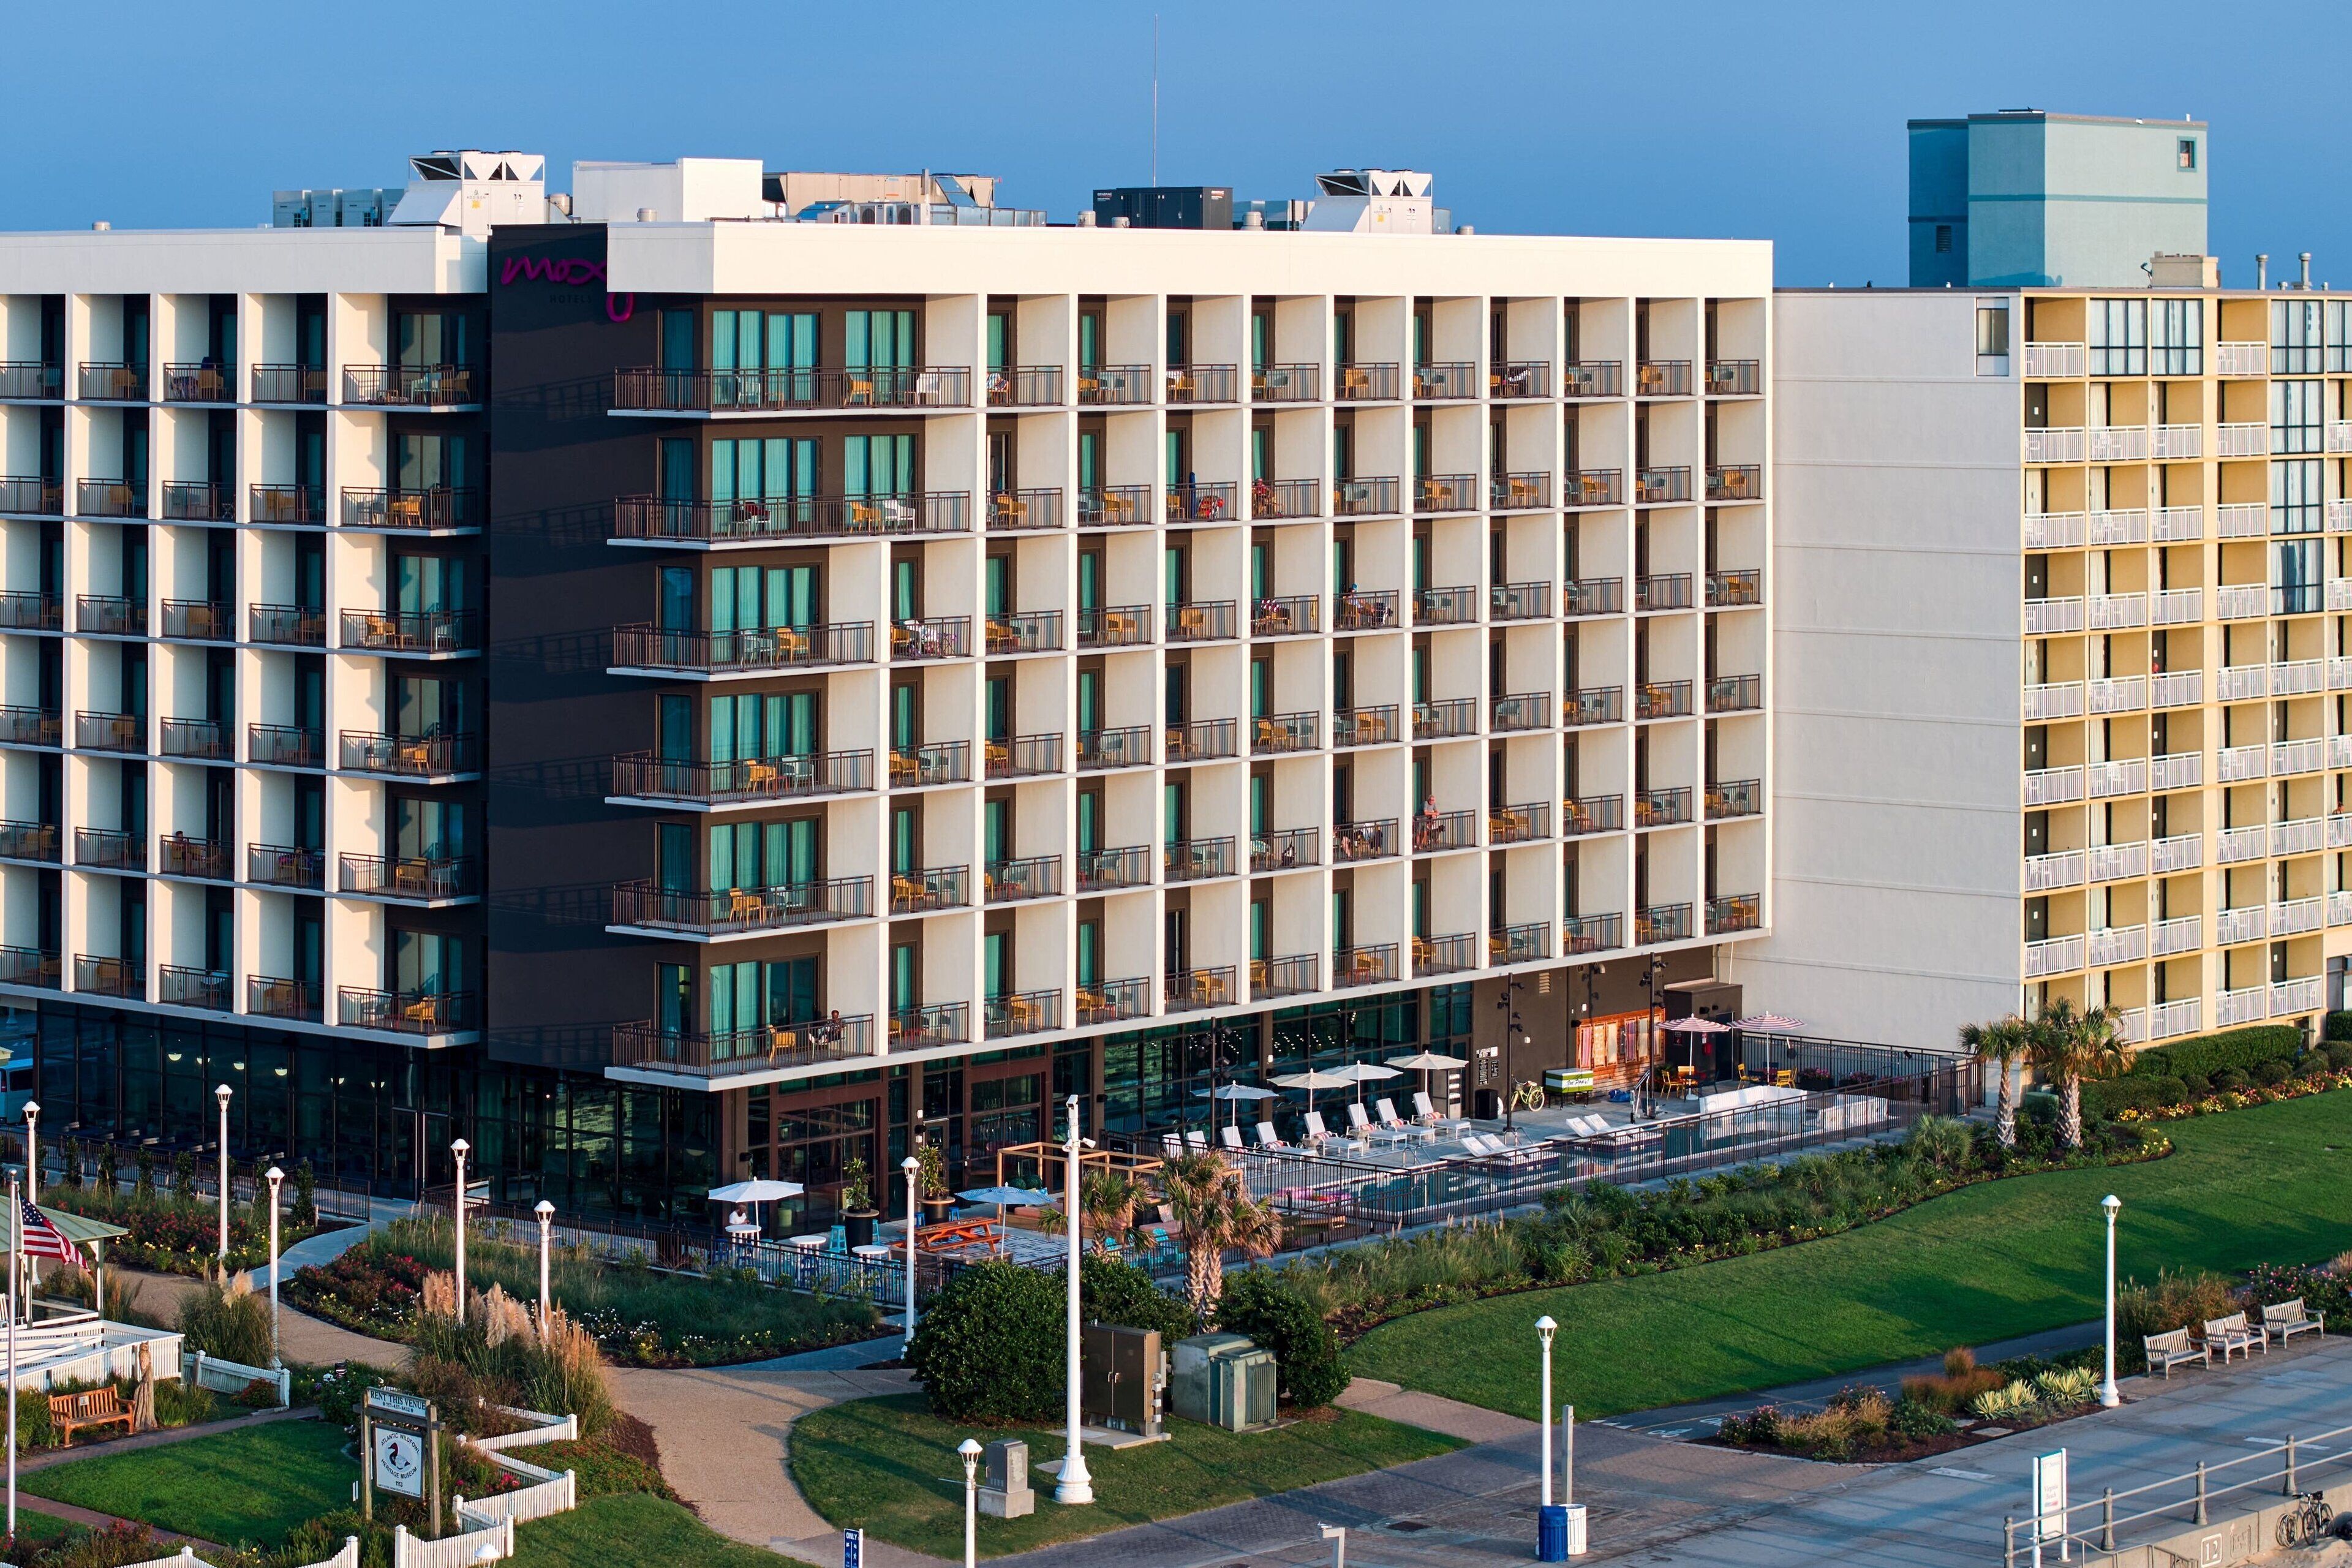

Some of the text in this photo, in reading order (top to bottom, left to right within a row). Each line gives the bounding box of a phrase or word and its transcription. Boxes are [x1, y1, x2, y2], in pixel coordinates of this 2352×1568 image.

[549, 294, 592, 304] HOTELS
[371, 1390, 426, 1410] RENT THIS VENUE
[381, 1433, 420, 1454] ATLANTIC WILDFOWL
[381, 1458, 418, 1479] HERITAGE MUSEUM
[846, 1532, 858, 1540] ONLY
[2206, 1540, 2218, 1561] 12
